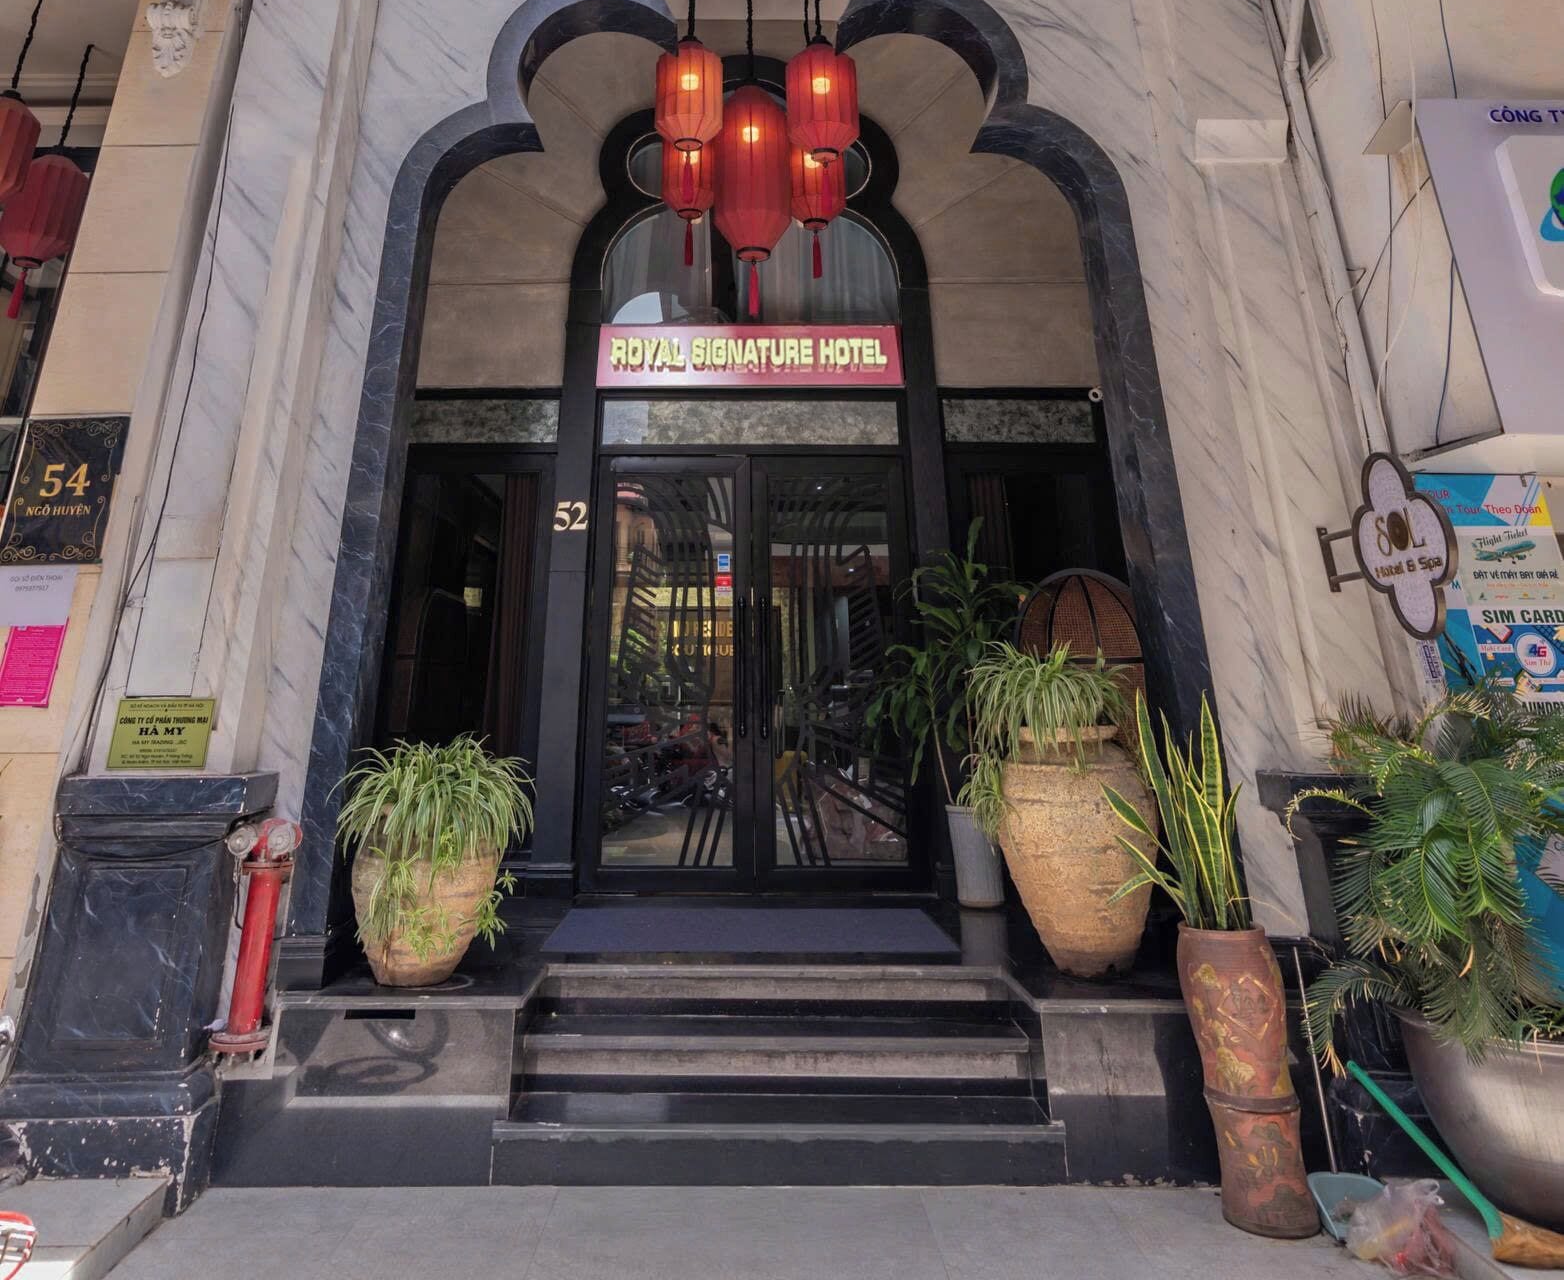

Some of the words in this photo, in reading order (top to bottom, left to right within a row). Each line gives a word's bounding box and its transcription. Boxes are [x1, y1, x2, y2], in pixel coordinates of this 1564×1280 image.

[1489, 105, 1543, 123] CÔNG
[610, 337, 686, 367] ROYAL
[691, 337, 814, 367] SIGNATURE
[819, 337, 888, 366] HOTEL
[39, 463, 91, 498] 54
[25, 504, 51, 517] NGÕ
[553, 501, 588, 531] 52
[1456, 504, 1480, 514] Tour
[1483, 504, 1512, 514] Theo
[1375, 561, 1405, 578] Hotel
[1418, 556, 1443, 572] Spa
[1482, 609, 1516, 624] SIM
[1520, 609, 1564, 624] CARD
[1528, 644, 1548, 658] 4G
[139, 725, 159, 736] HÀ
[164, 727, 185, 736] MY
